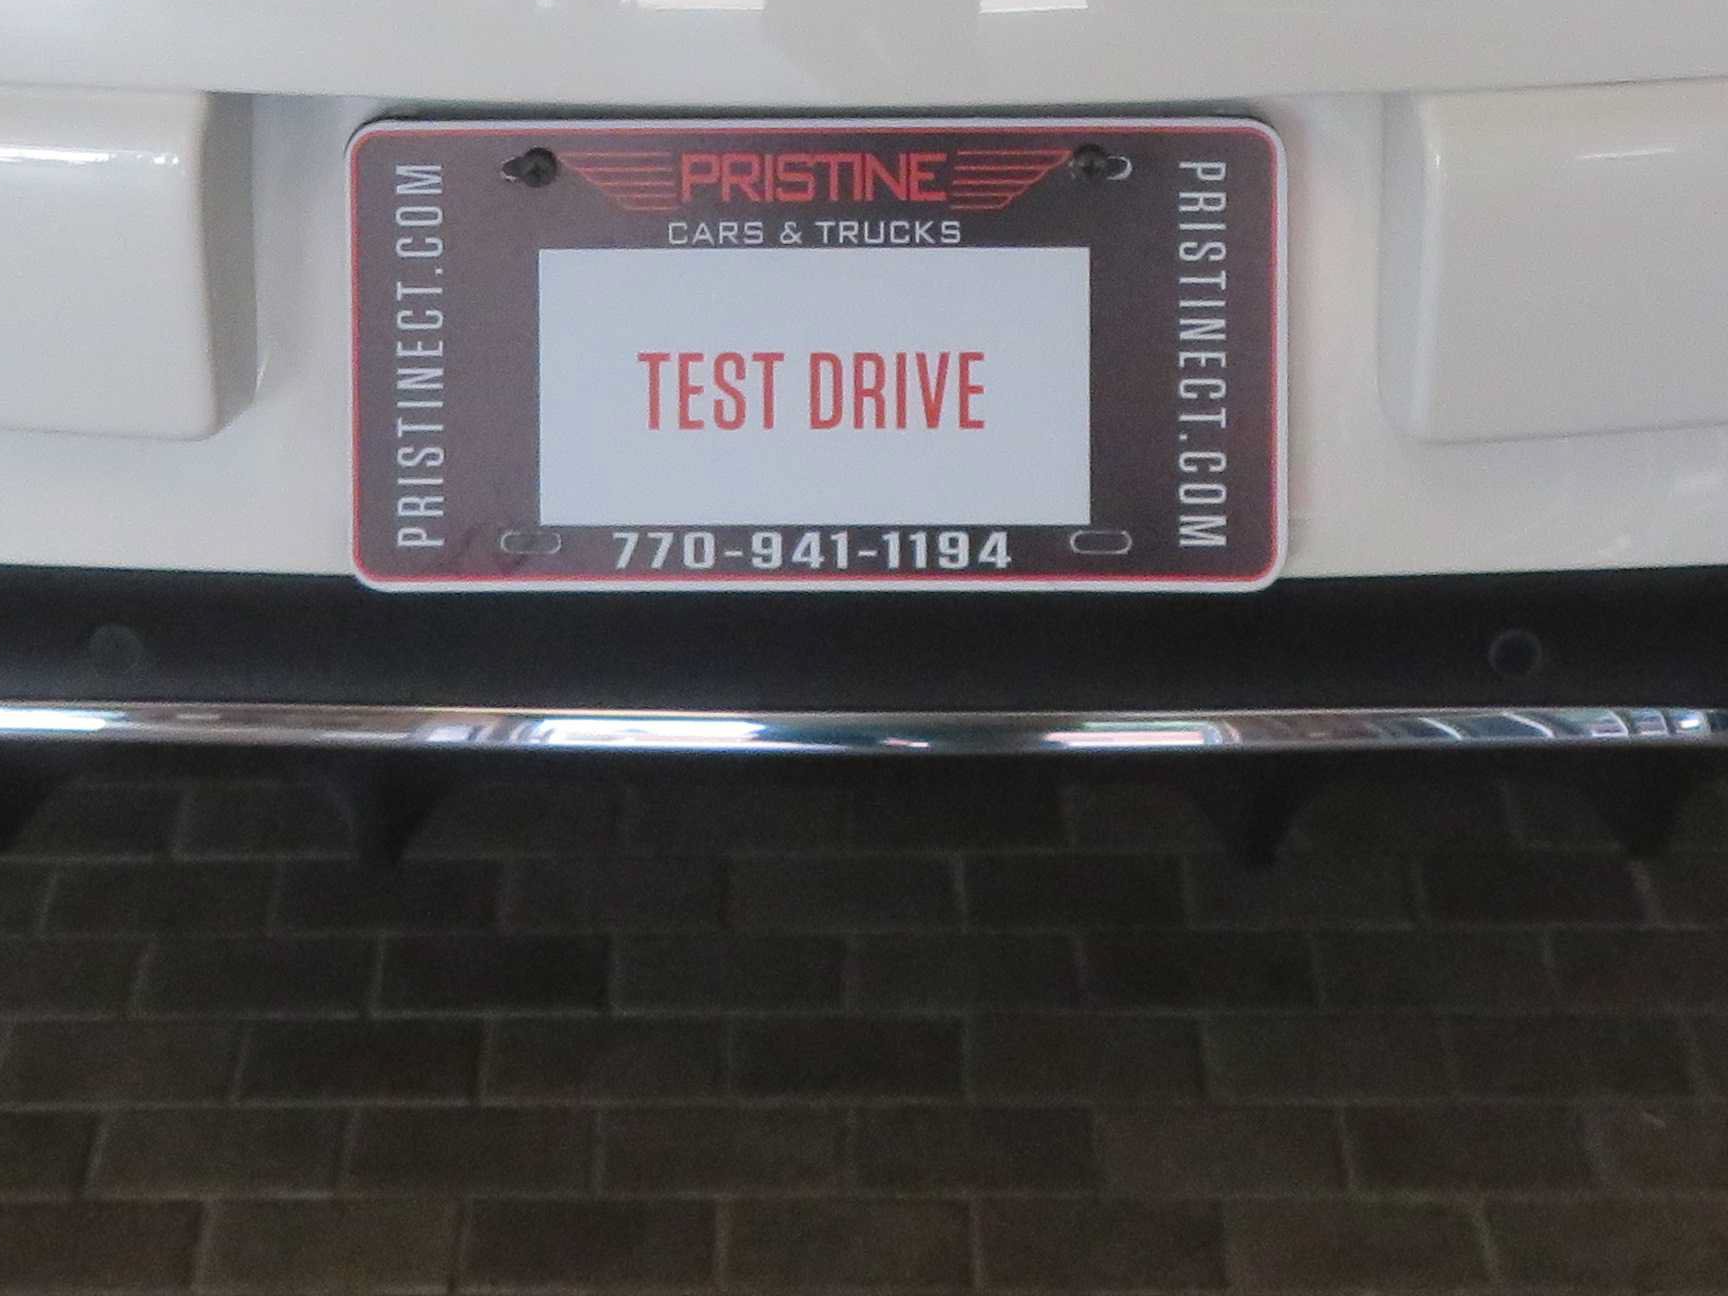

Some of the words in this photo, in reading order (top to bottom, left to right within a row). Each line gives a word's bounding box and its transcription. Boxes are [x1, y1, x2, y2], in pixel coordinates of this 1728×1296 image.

[680, 151, 948, 203] PRISTINE
[667, 221, 764, 245] CARS
[779, 220, 802, 245] &
[814, 219, 962, 245] TRUCKS
[395, 163, 445, 549] PRISTINECT.COM
[1178, 160, 1228, 548] PRISTINECT.COM
[637, 351, 785, 431] TEST
[808, 350, 986, 431] DRIVE
[611, 529, 1013, 571] 770-941-1194
